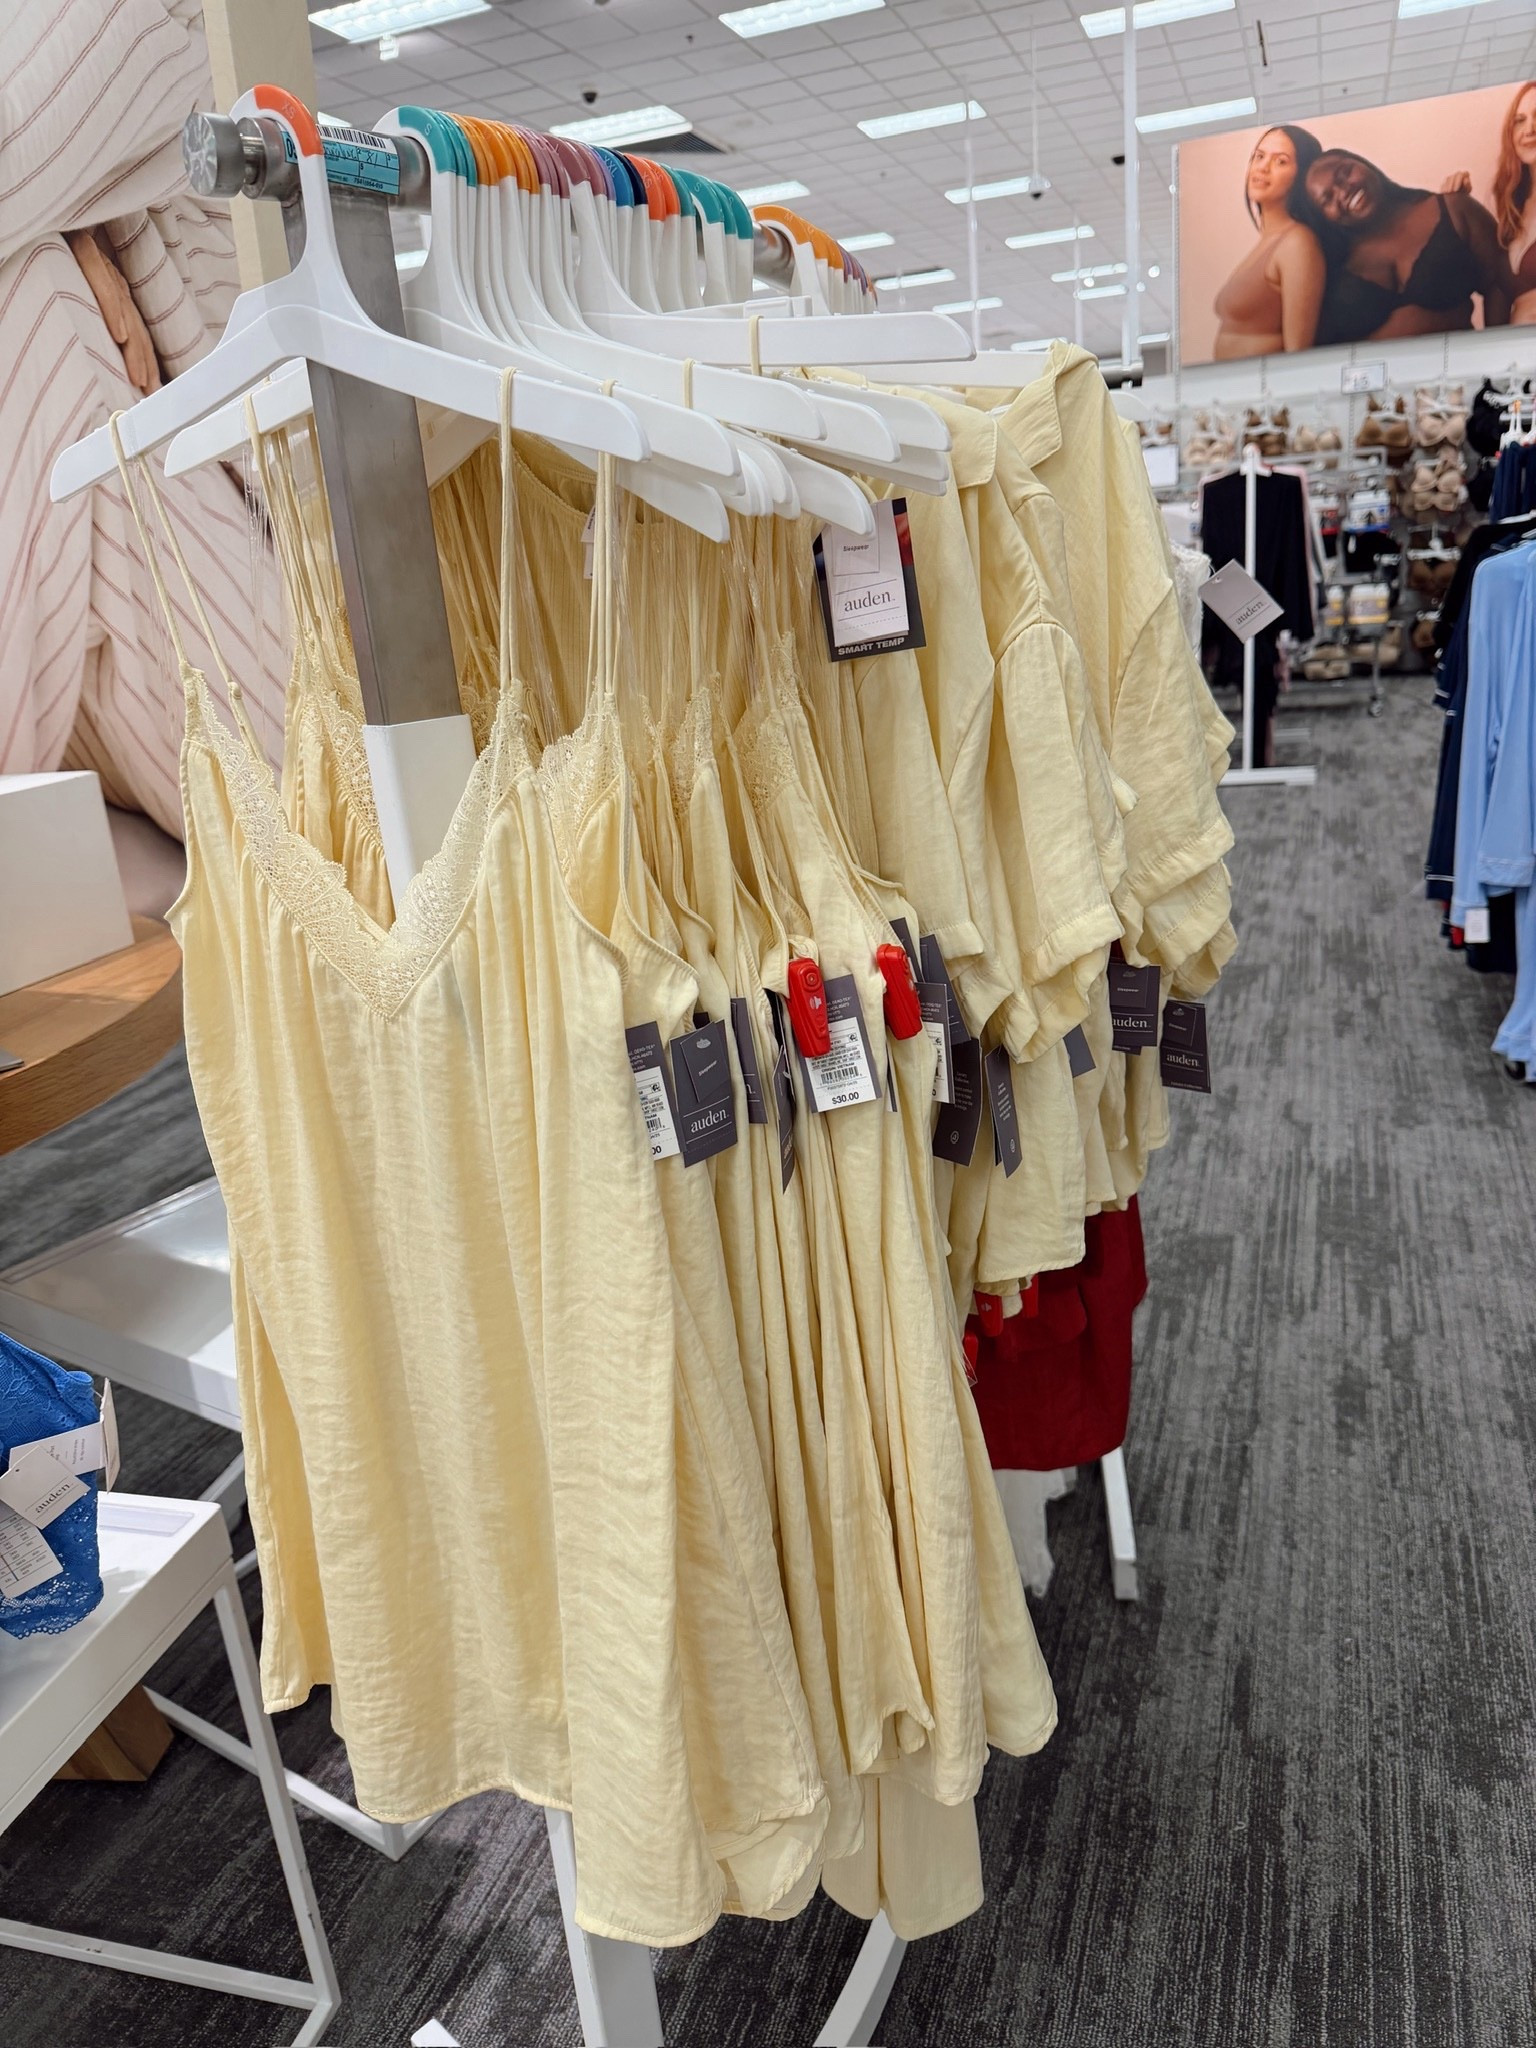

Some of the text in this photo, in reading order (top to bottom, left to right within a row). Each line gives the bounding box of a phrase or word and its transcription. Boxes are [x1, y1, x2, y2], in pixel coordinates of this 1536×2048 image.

[281, 102, 296, 119] XS
[424, 123, 432, 136] S
[604, 156, 615, 178] XXL
[837, 636, 905, 656] SMART TEMP
[831, 1091, 860, 1105] $30.00
[690, 1109, 728, 1134] auden
[34, 1483, 71, 1514] auden
